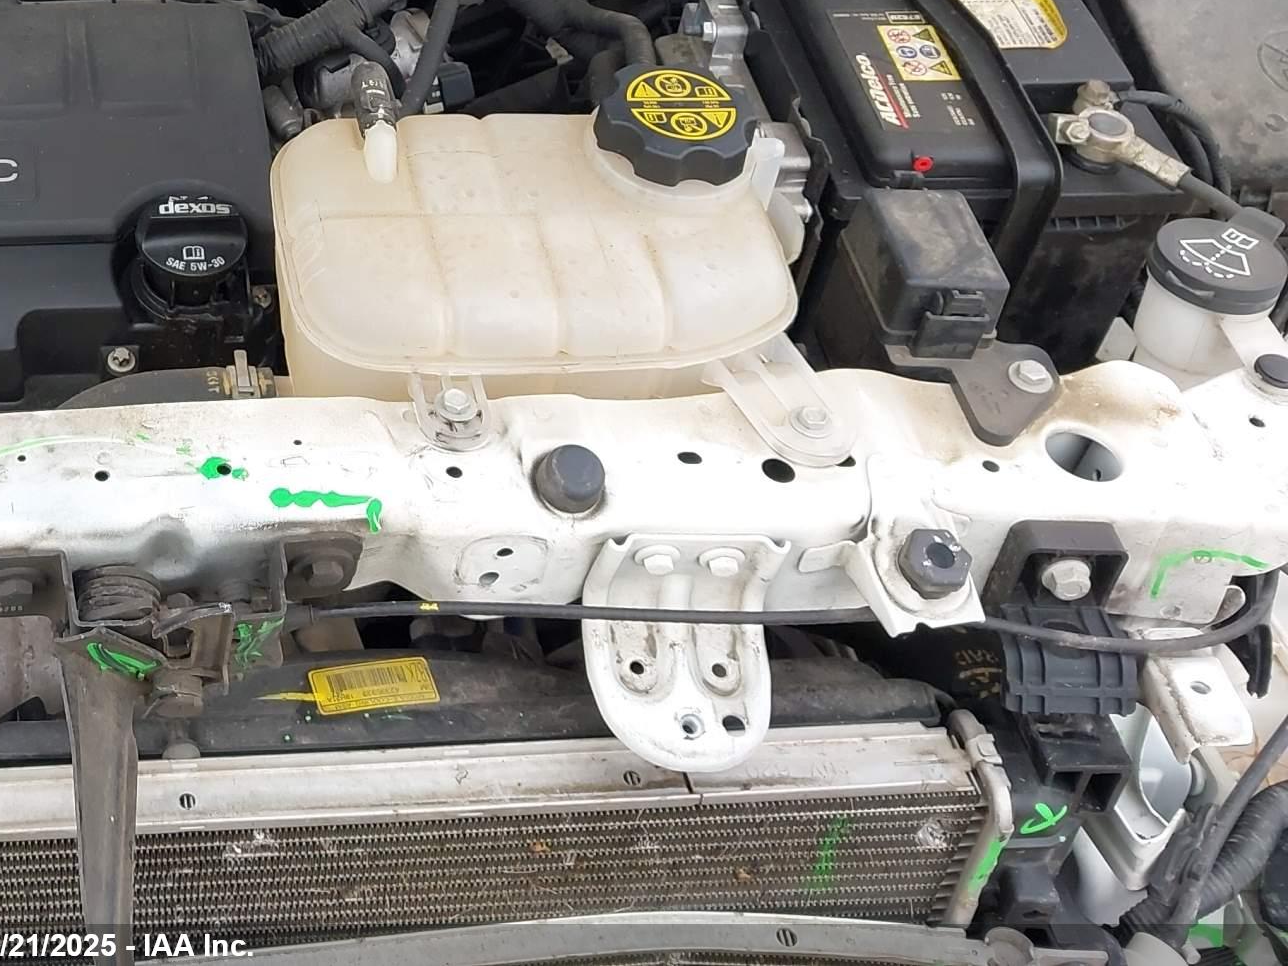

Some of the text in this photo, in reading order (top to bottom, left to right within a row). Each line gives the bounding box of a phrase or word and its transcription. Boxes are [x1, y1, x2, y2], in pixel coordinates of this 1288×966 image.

[856, 54, 902, 126] ACDelco
[158, 199, 232, 214] dexos
[166, 256, 226, 271] SAE 5W-30
